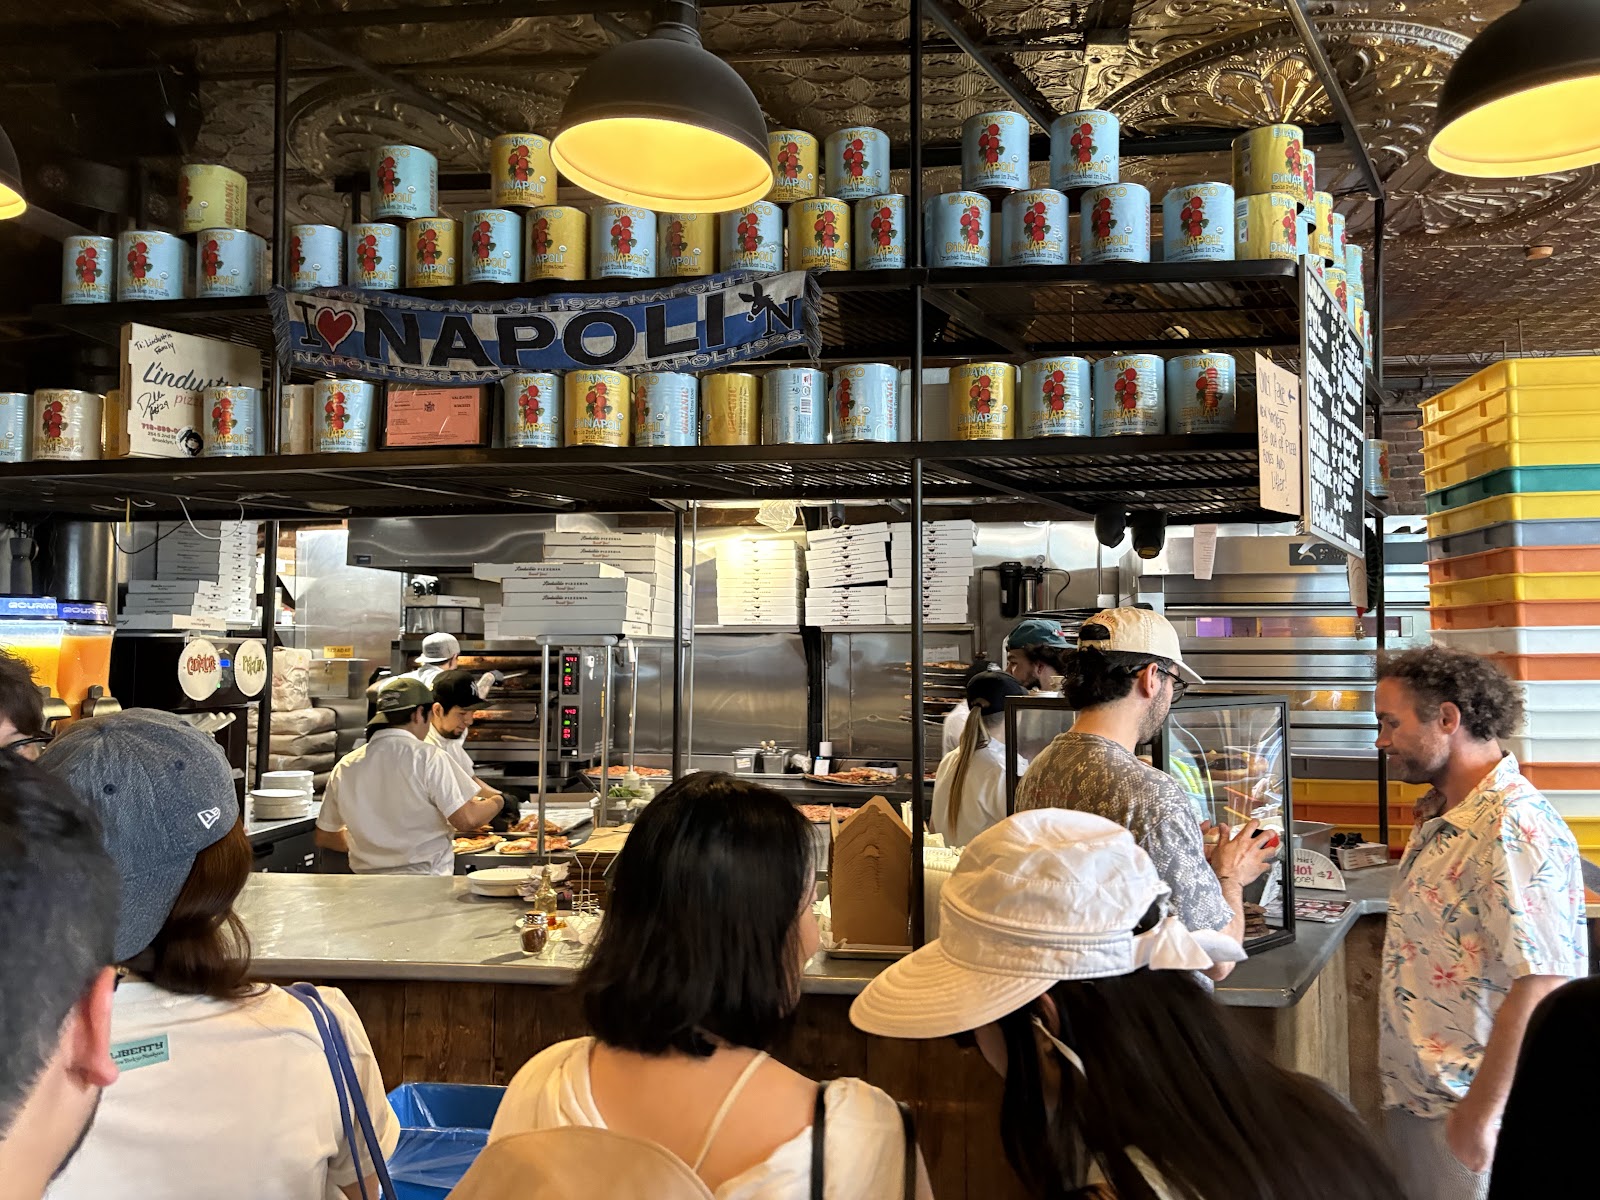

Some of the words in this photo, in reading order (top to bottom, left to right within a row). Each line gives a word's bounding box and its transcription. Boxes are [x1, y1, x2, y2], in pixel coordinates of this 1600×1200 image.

[1272, 127, 1302, 139] BIAN
[776, 177, 812, 190] NAPOLI
[1271, 173, 1302, 184] DiNAP
[501, 179, 544, 193] NAPOLI
[295, 300, 323, 348] I
[362, 289, 727, 369] NAPOLI
[109, 1041, 164, 1060] LIBERTY
